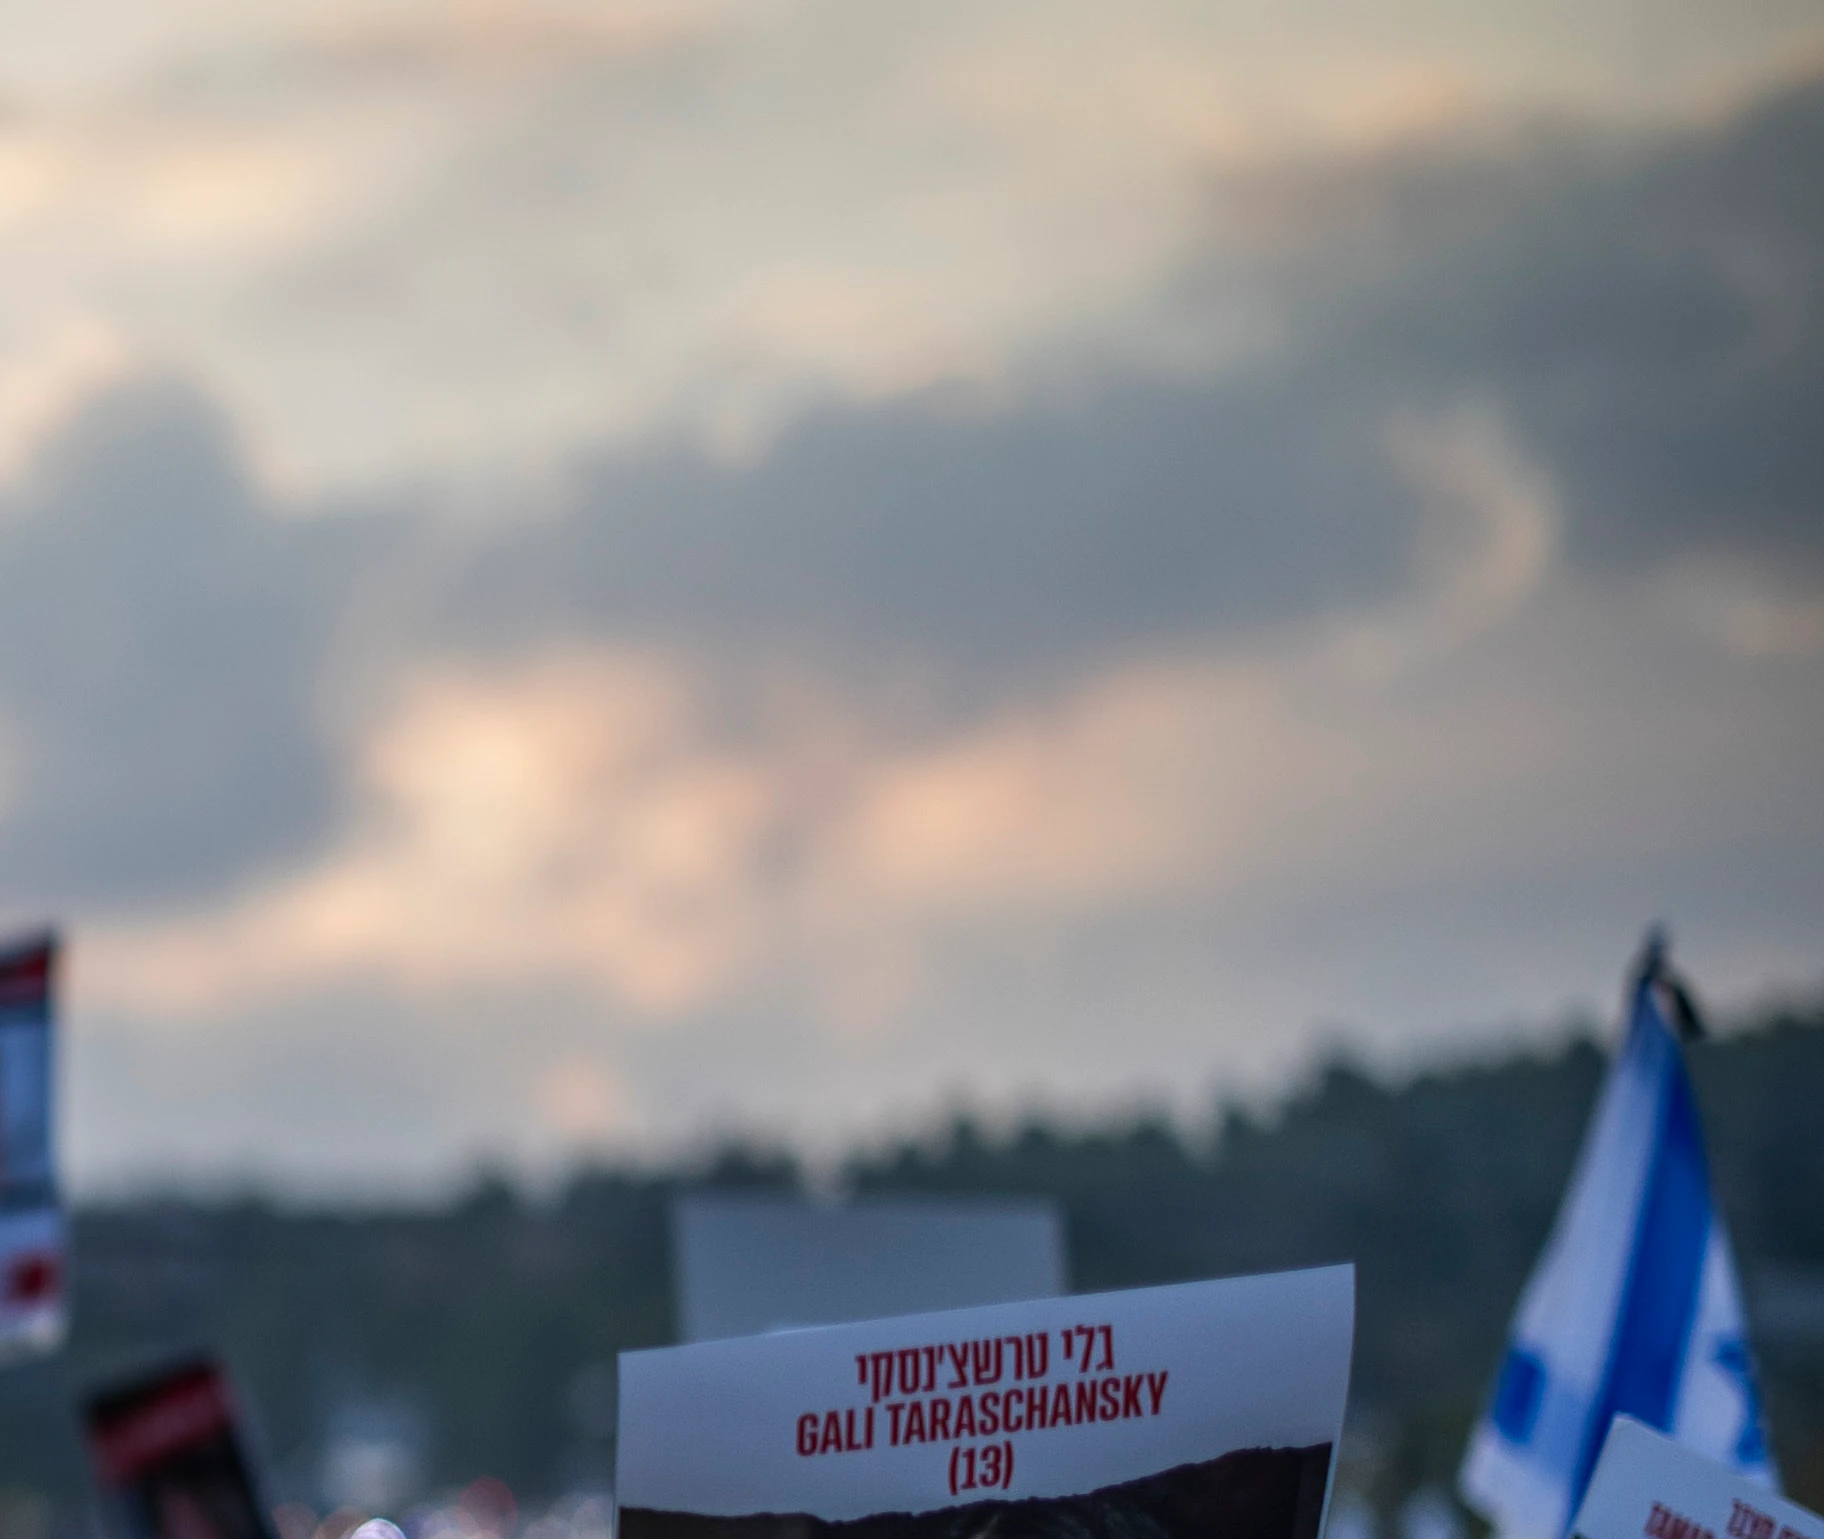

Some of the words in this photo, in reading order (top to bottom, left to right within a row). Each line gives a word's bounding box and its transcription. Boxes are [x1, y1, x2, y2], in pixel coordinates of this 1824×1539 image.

[1061, 1324, 1115, 1374] גלי
[796, 1406, 876, 1457] GALI
[885, 1370, 1169, 1447] TARASCHANSKY
[948, 1440, 1015, 1497] (13)
